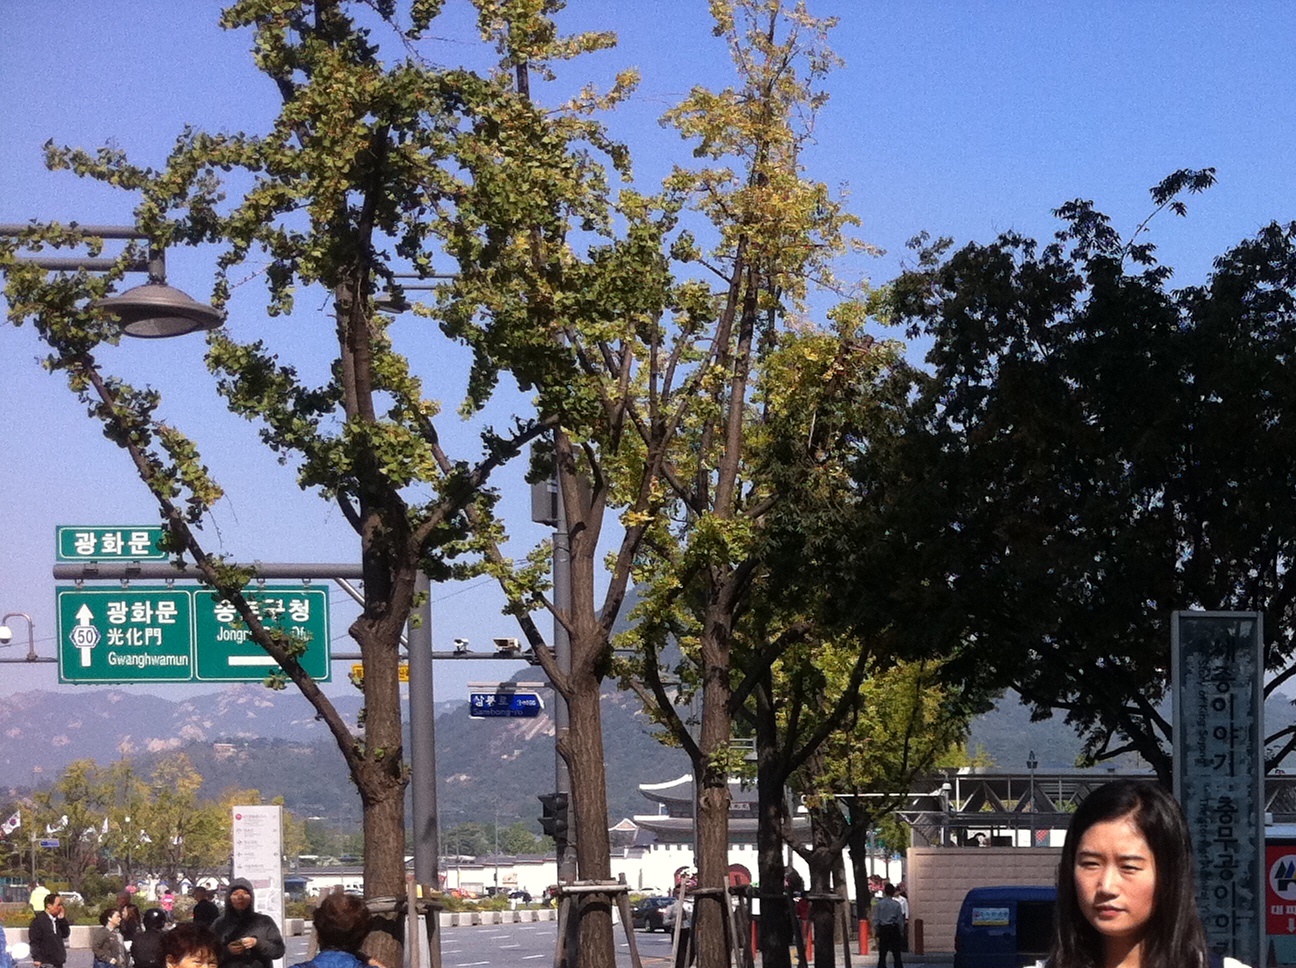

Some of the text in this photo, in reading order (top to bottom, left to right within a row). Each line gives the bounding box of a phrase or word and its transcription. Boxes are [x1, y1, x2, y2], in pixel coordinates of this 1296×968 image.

[74, 531, 151, 555] 광화문
[106, 601, 178, 624] 광화문
[77, 629, 94, 644] 50
[107, 628, 162, 646] 光化門
[108, 651, 189, 669] Gwanghwamun
[1198, 704, 1210, 727] King
